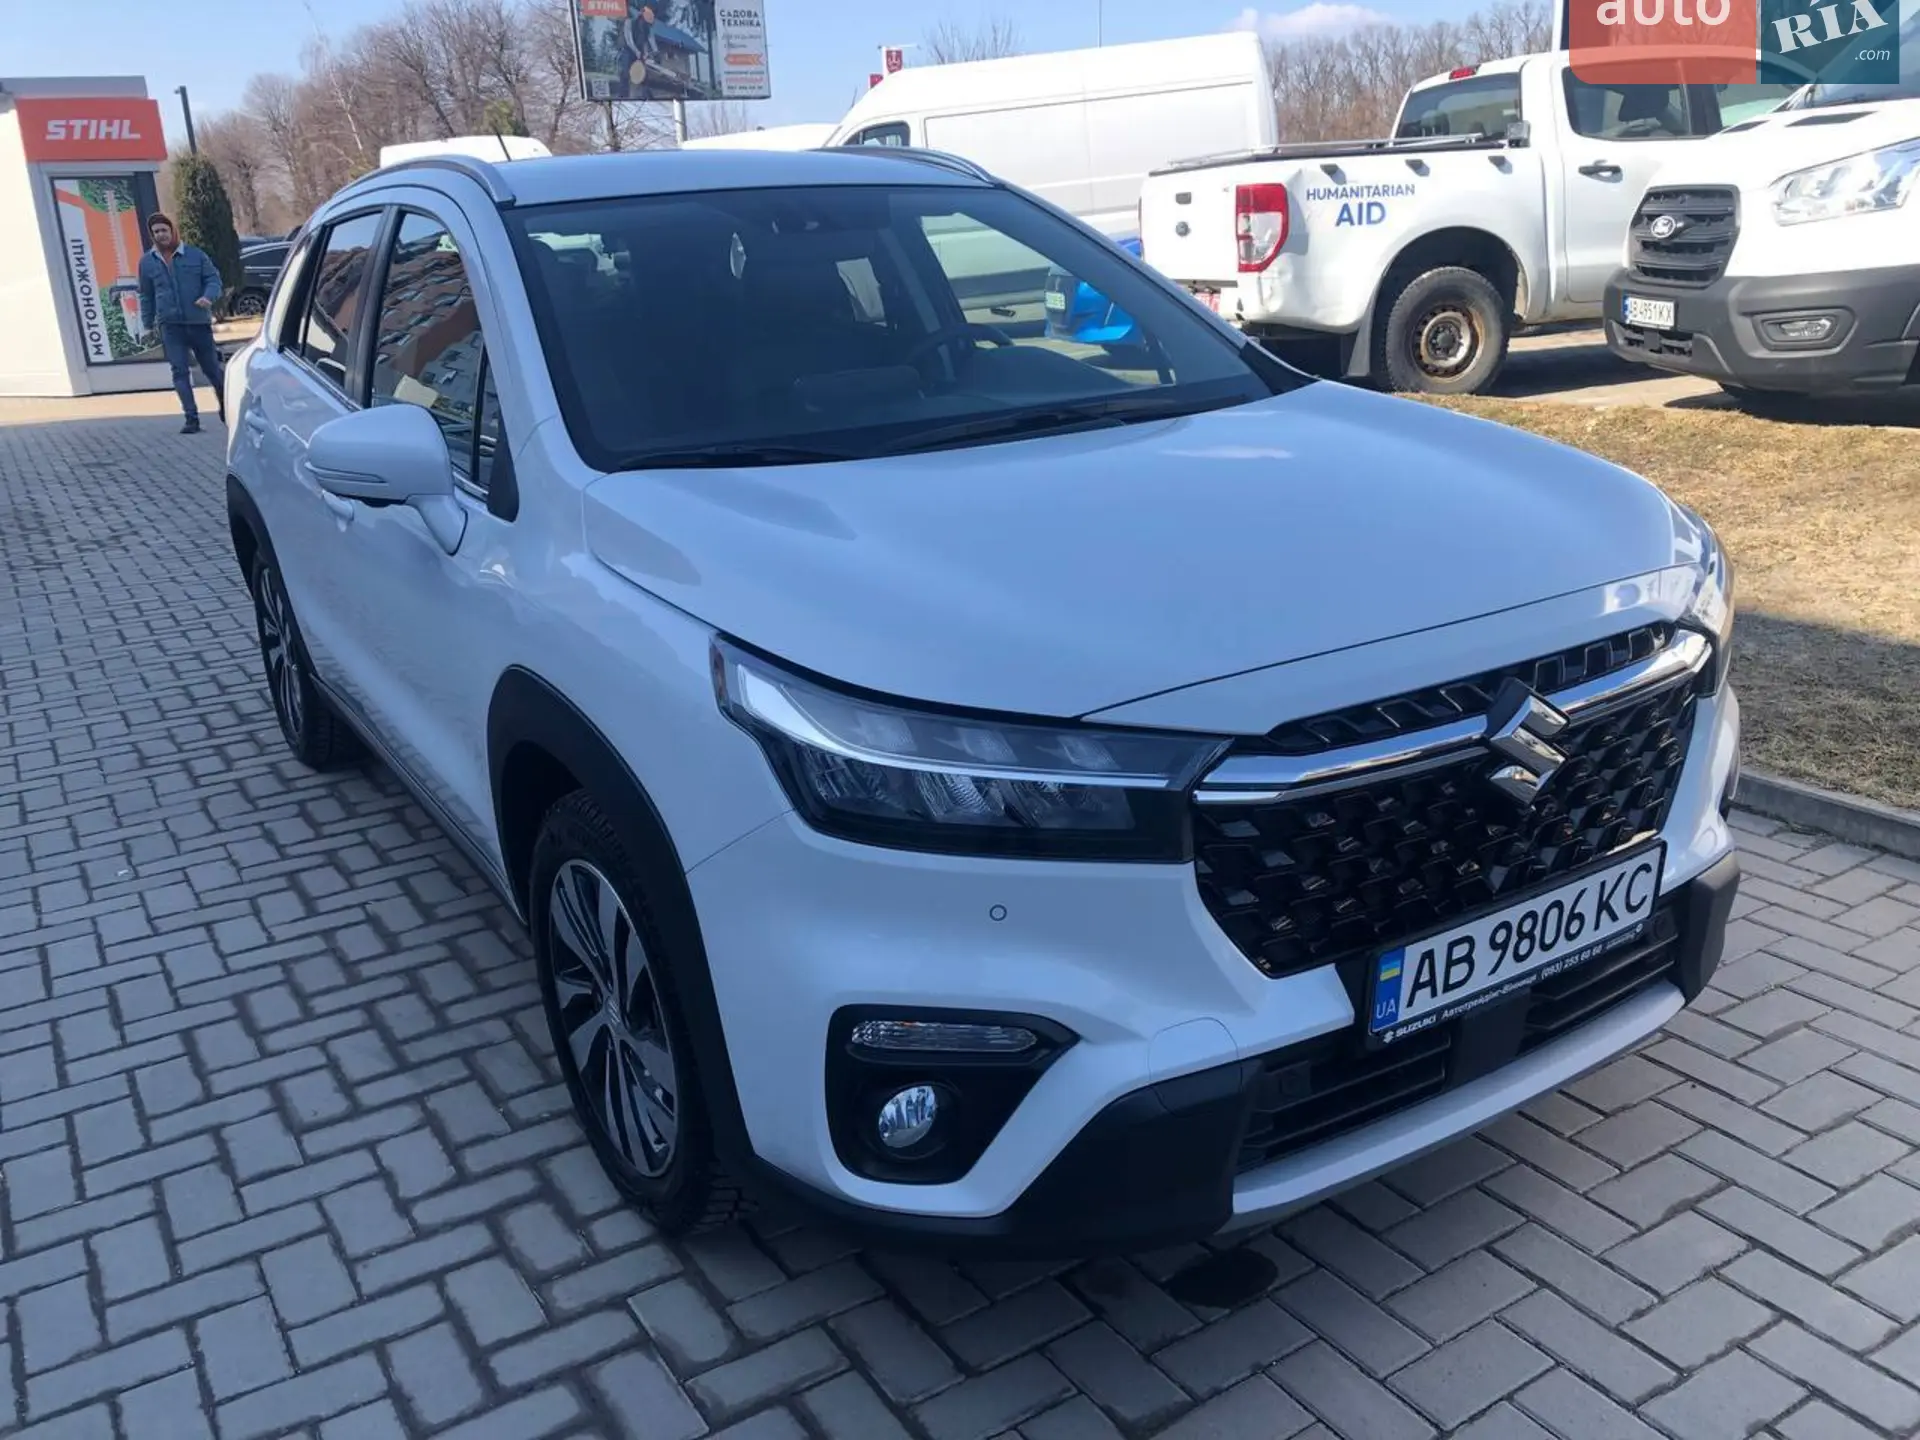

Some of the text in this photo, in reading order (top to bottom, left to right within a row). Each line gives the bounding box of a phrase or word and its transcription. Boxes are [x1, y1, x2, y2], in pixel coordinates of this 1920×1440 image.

[720, 9, 759, 18] САДОВА
[722, 19, 761, 27] ТЕХНІКА
[45, 119, 141, 140] STIHL
[1306, 184, 1415, 201] HUMANITARIAN
[1335, 201, 1386, 227] AID
[70, 239, 104, 356] МОТОНОЖИЦІ
[1406, 863, 1653, 1008] AB 9806 KC
[1375, 997, 1397, 1020] UA
[1396, 1014, 1437, 1038] SUZUKI
